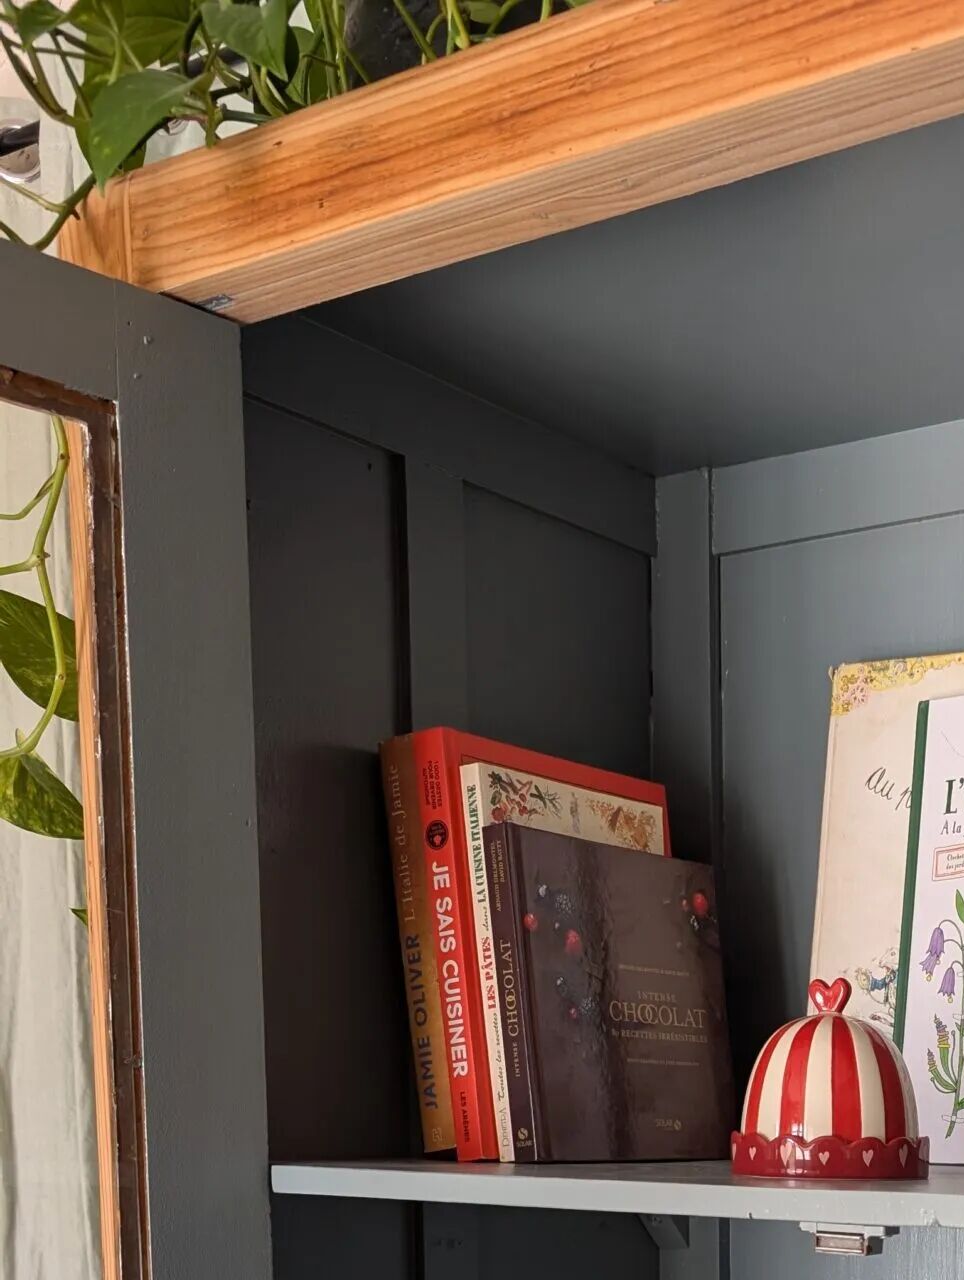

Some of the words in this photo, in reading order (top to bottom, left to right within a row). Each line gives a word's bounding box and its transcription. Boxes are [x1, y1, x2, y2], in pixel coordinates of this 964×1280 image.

[390, 762, 406, 818] Jamie
[395, 824, 406, 846] de
[467, 784, 481, 842] ITALIENNE
[952, 821, 962, 834] la
[432, 862, 450, 890] JE
[473, 844, 485, 887] CUISINE
[477, 889, 486, 903] LA
[436, 897, 456, 953] SAIS
[406, 934, 427, 1026] OLIVER
[481, 937, 494, 981] PÂTES
[487, 984, 498, 1009] LES
[500, 939, 519, 1037] CHOCOLAT
[442, 960, 468, 1078] CUISINER
[609, 1000, 706, 1028] CHOCOLAT
[418, 1036, 438, 1109] JAMIE
